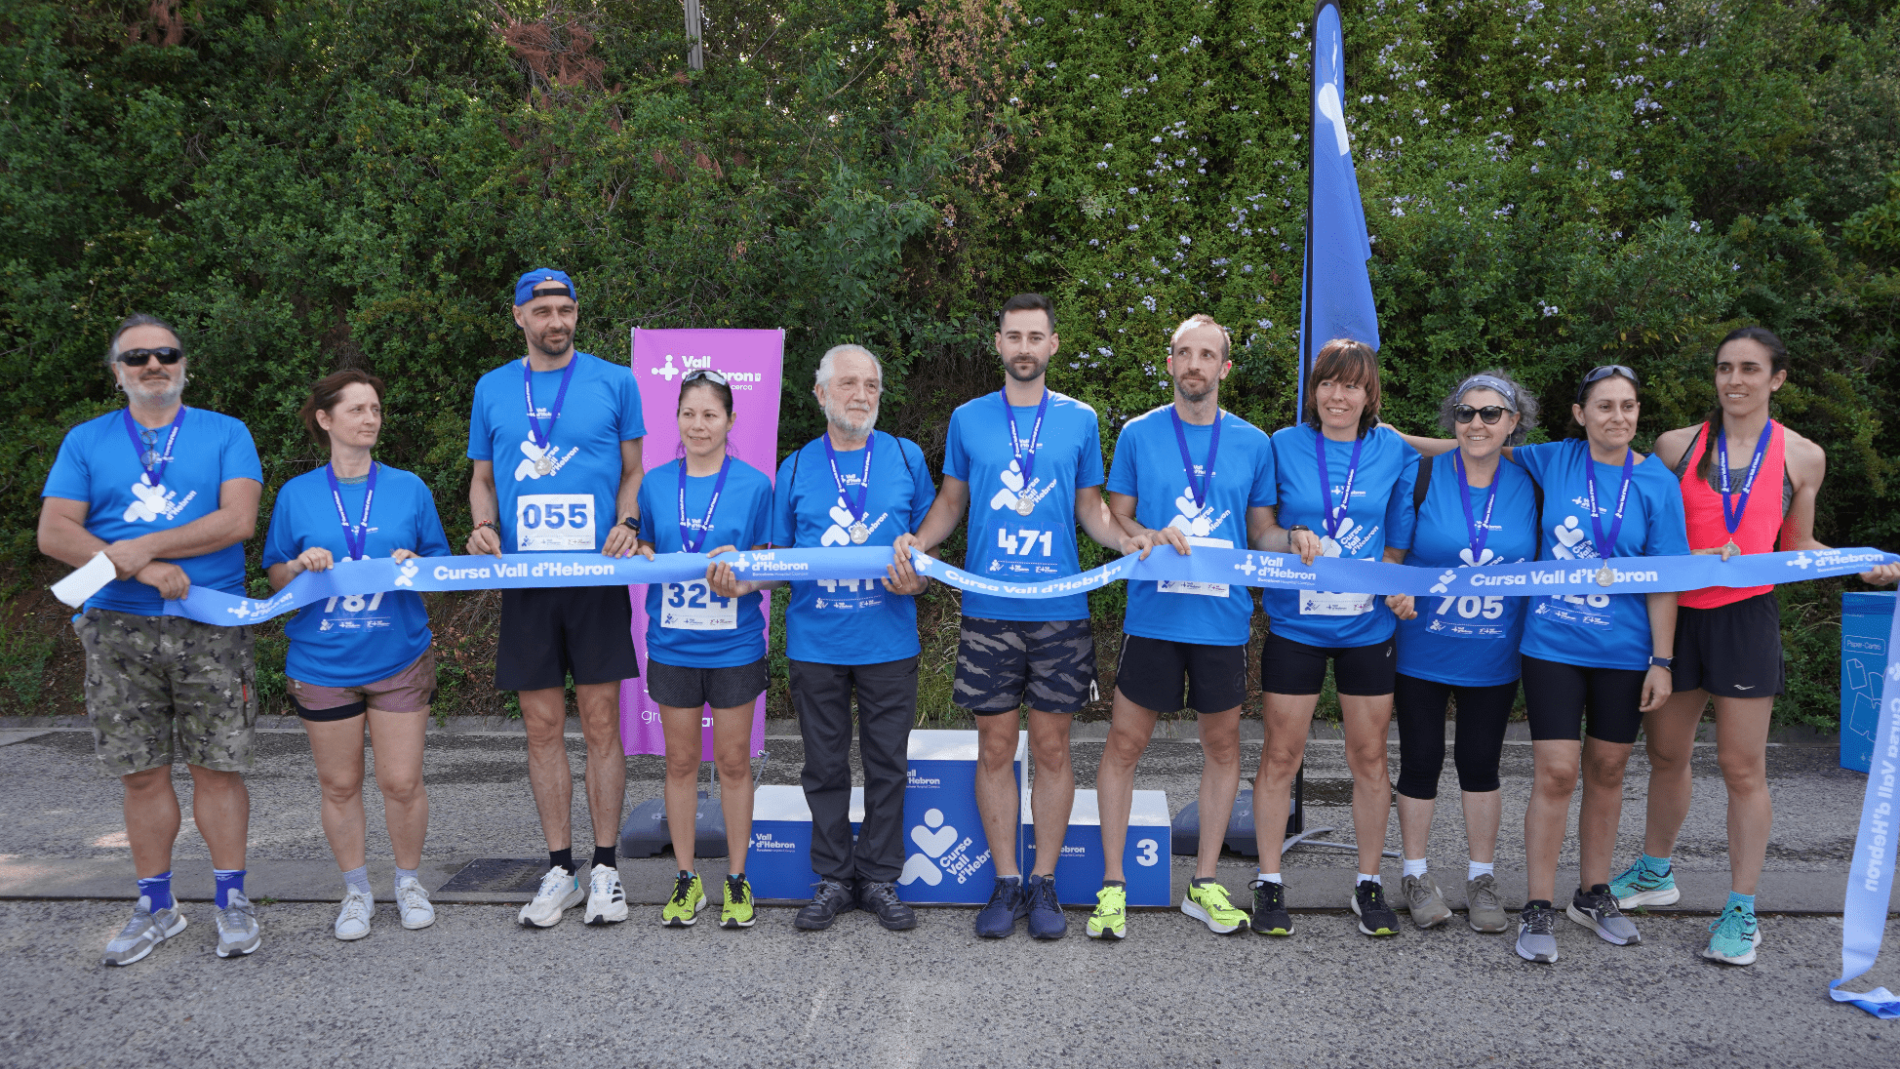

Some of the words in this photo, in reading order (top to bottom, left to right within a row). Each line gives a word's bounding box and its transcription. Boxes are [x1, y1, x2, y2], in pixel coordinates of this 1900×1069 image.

[681, 355, 711, 368] Vall
[523, 503, 588, 529] 055
[998, 528, 1053, 557] 471
[1340, 524, 1364, 545] Cursa
[1344, 535, 1361, 550] Vall
[751, 552, 775, 562] Vall
[1260, 555, 1284, 567] Vall
[1812, 549, 1841, 557] Vall
[1815, 553, 1884, 567] d'Hebron
[433, 565, 491, 581] Cursa
[493, 563, 528, 578] Vall
[531, 562, 615, 577] d'Hebron
[751, 561, 809, 572] d'Hebron
[1258, 567, 1317, 580] d'Hebron
[945, 570, 999, 592] Cursa
[1003, 585, 1037, 595] Vall
[1470, 573, 1527, 587] Cursa
[1530, 570, 1565, 585] Vall
[1569, 568, 1658, 584] d'Hbron
[668, 583, 731, 609] 324
[1436, 596, 1504, 619] 705
[906, 769, 917, 777] all
[756, 833, 772, 841] Vall
[756, 841, 796, 849] d'Hebron
[939, 836, 973, 868] Cursa
[1136, 838, 1159, 867] 3
[945, 853, 970, 876] Vall
